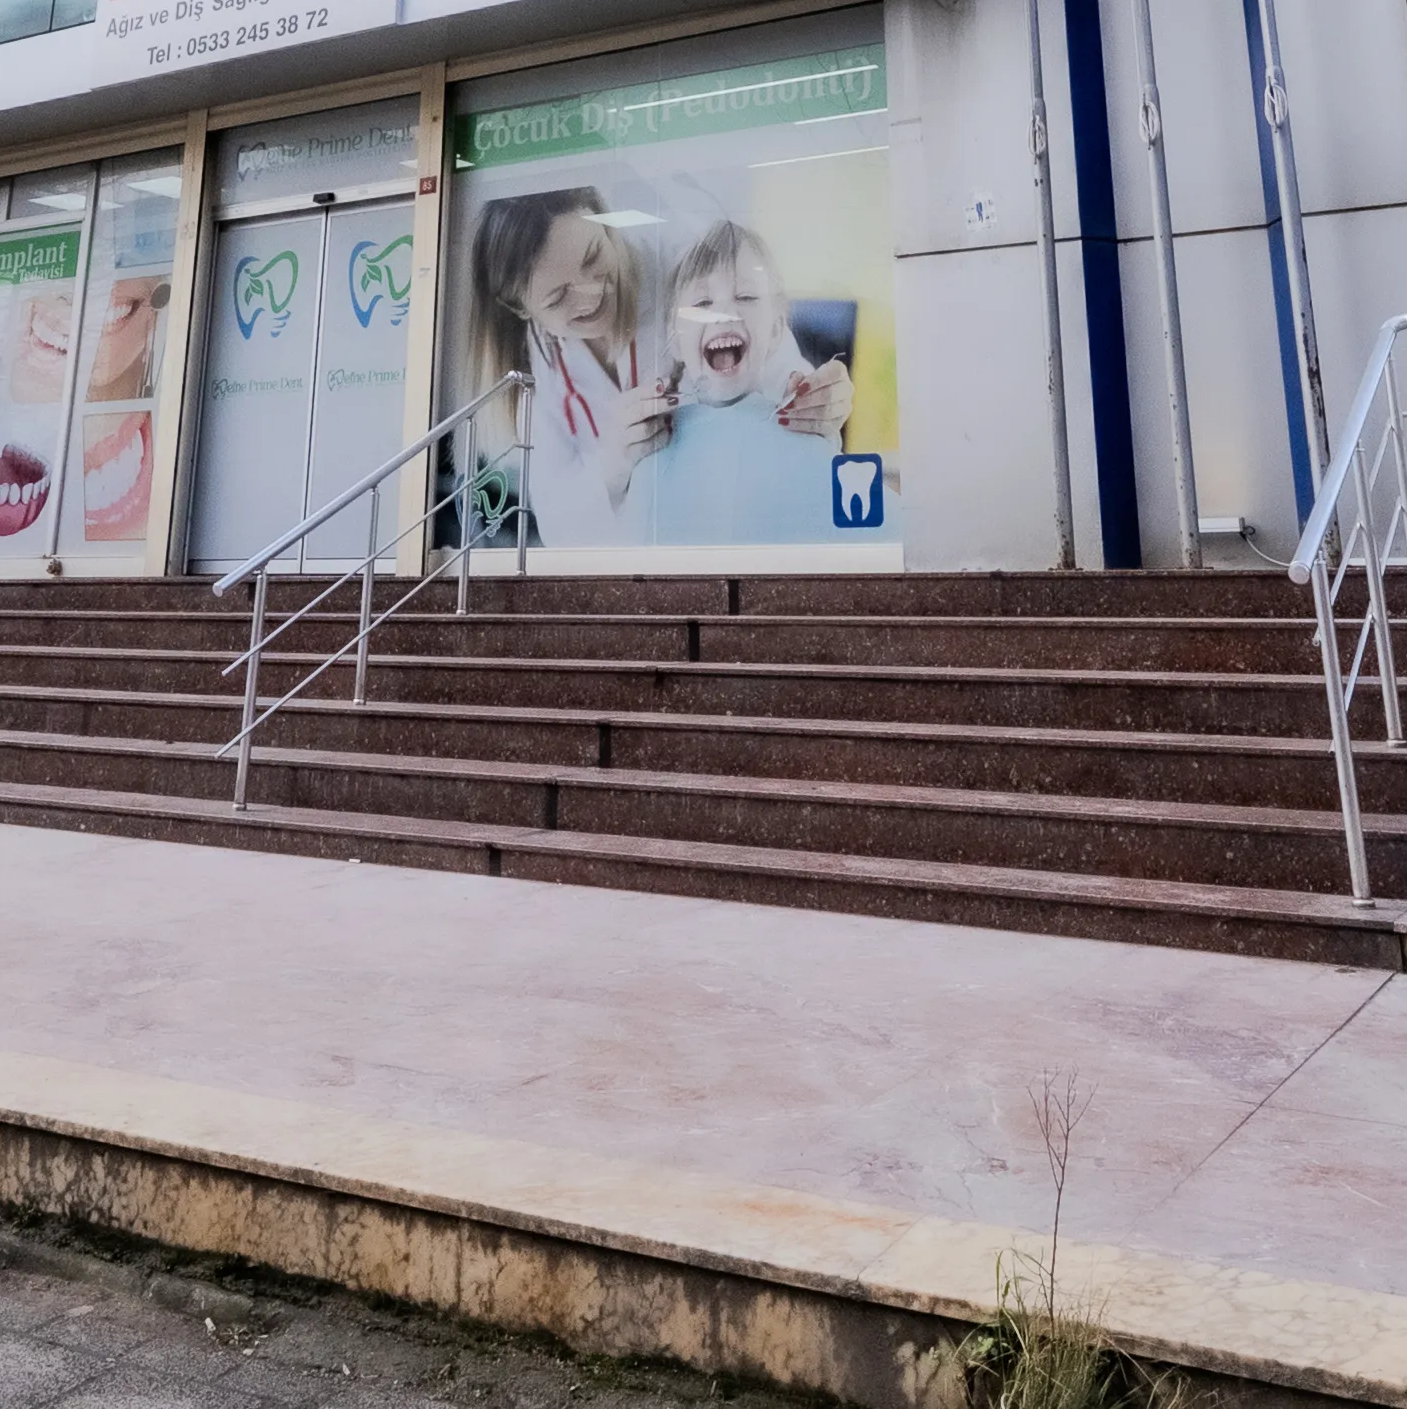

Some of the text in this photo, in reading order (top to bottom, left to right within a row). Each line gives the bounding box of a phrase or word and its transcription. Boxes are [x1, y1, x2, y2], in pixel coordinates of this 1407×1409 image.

[106, 14, 144, 38] Ağız
[149, 9, 169, 26] ve
[147, 43, 171, 65] Tel
[186, 30, 230, 56] 0533
[235, 21, 270, 46] 245
[275, 14, 299, 37] 38
[306, 7, 329, 30] 72
[308, 133, 363, 160] Prime
[369, 124, 411, 148] Dent
[474, 109, 572, 161] Çocuk
[582, 98, 634, 138] Diş
